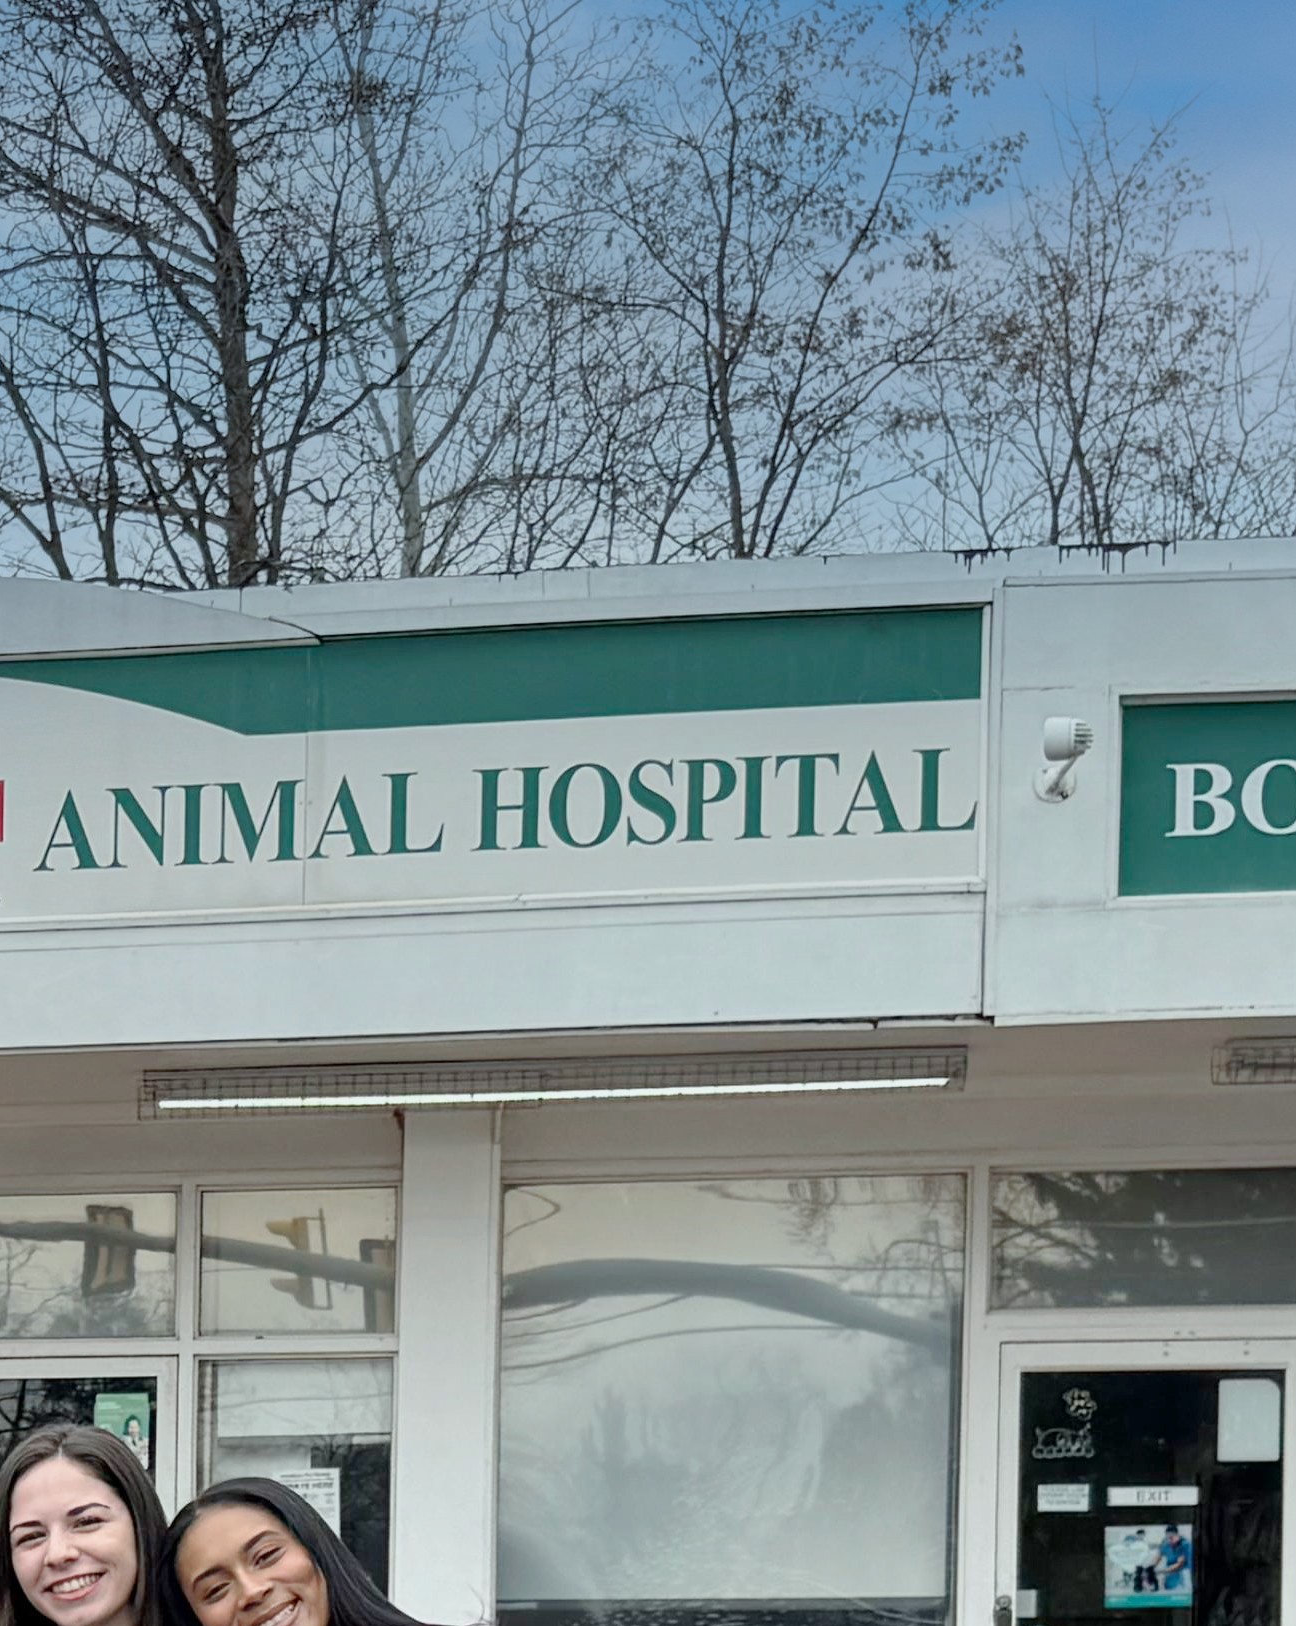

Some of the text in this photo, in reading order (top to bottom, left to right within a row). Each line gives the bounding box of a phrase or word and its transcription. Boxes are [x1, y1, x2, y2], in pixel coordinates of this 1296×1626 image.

[33, 771, 444, 872] ANIMAL
[470, 747, 978, 853] HOSPITAL
[1136, 1490, 1172, 1503] EXIT
